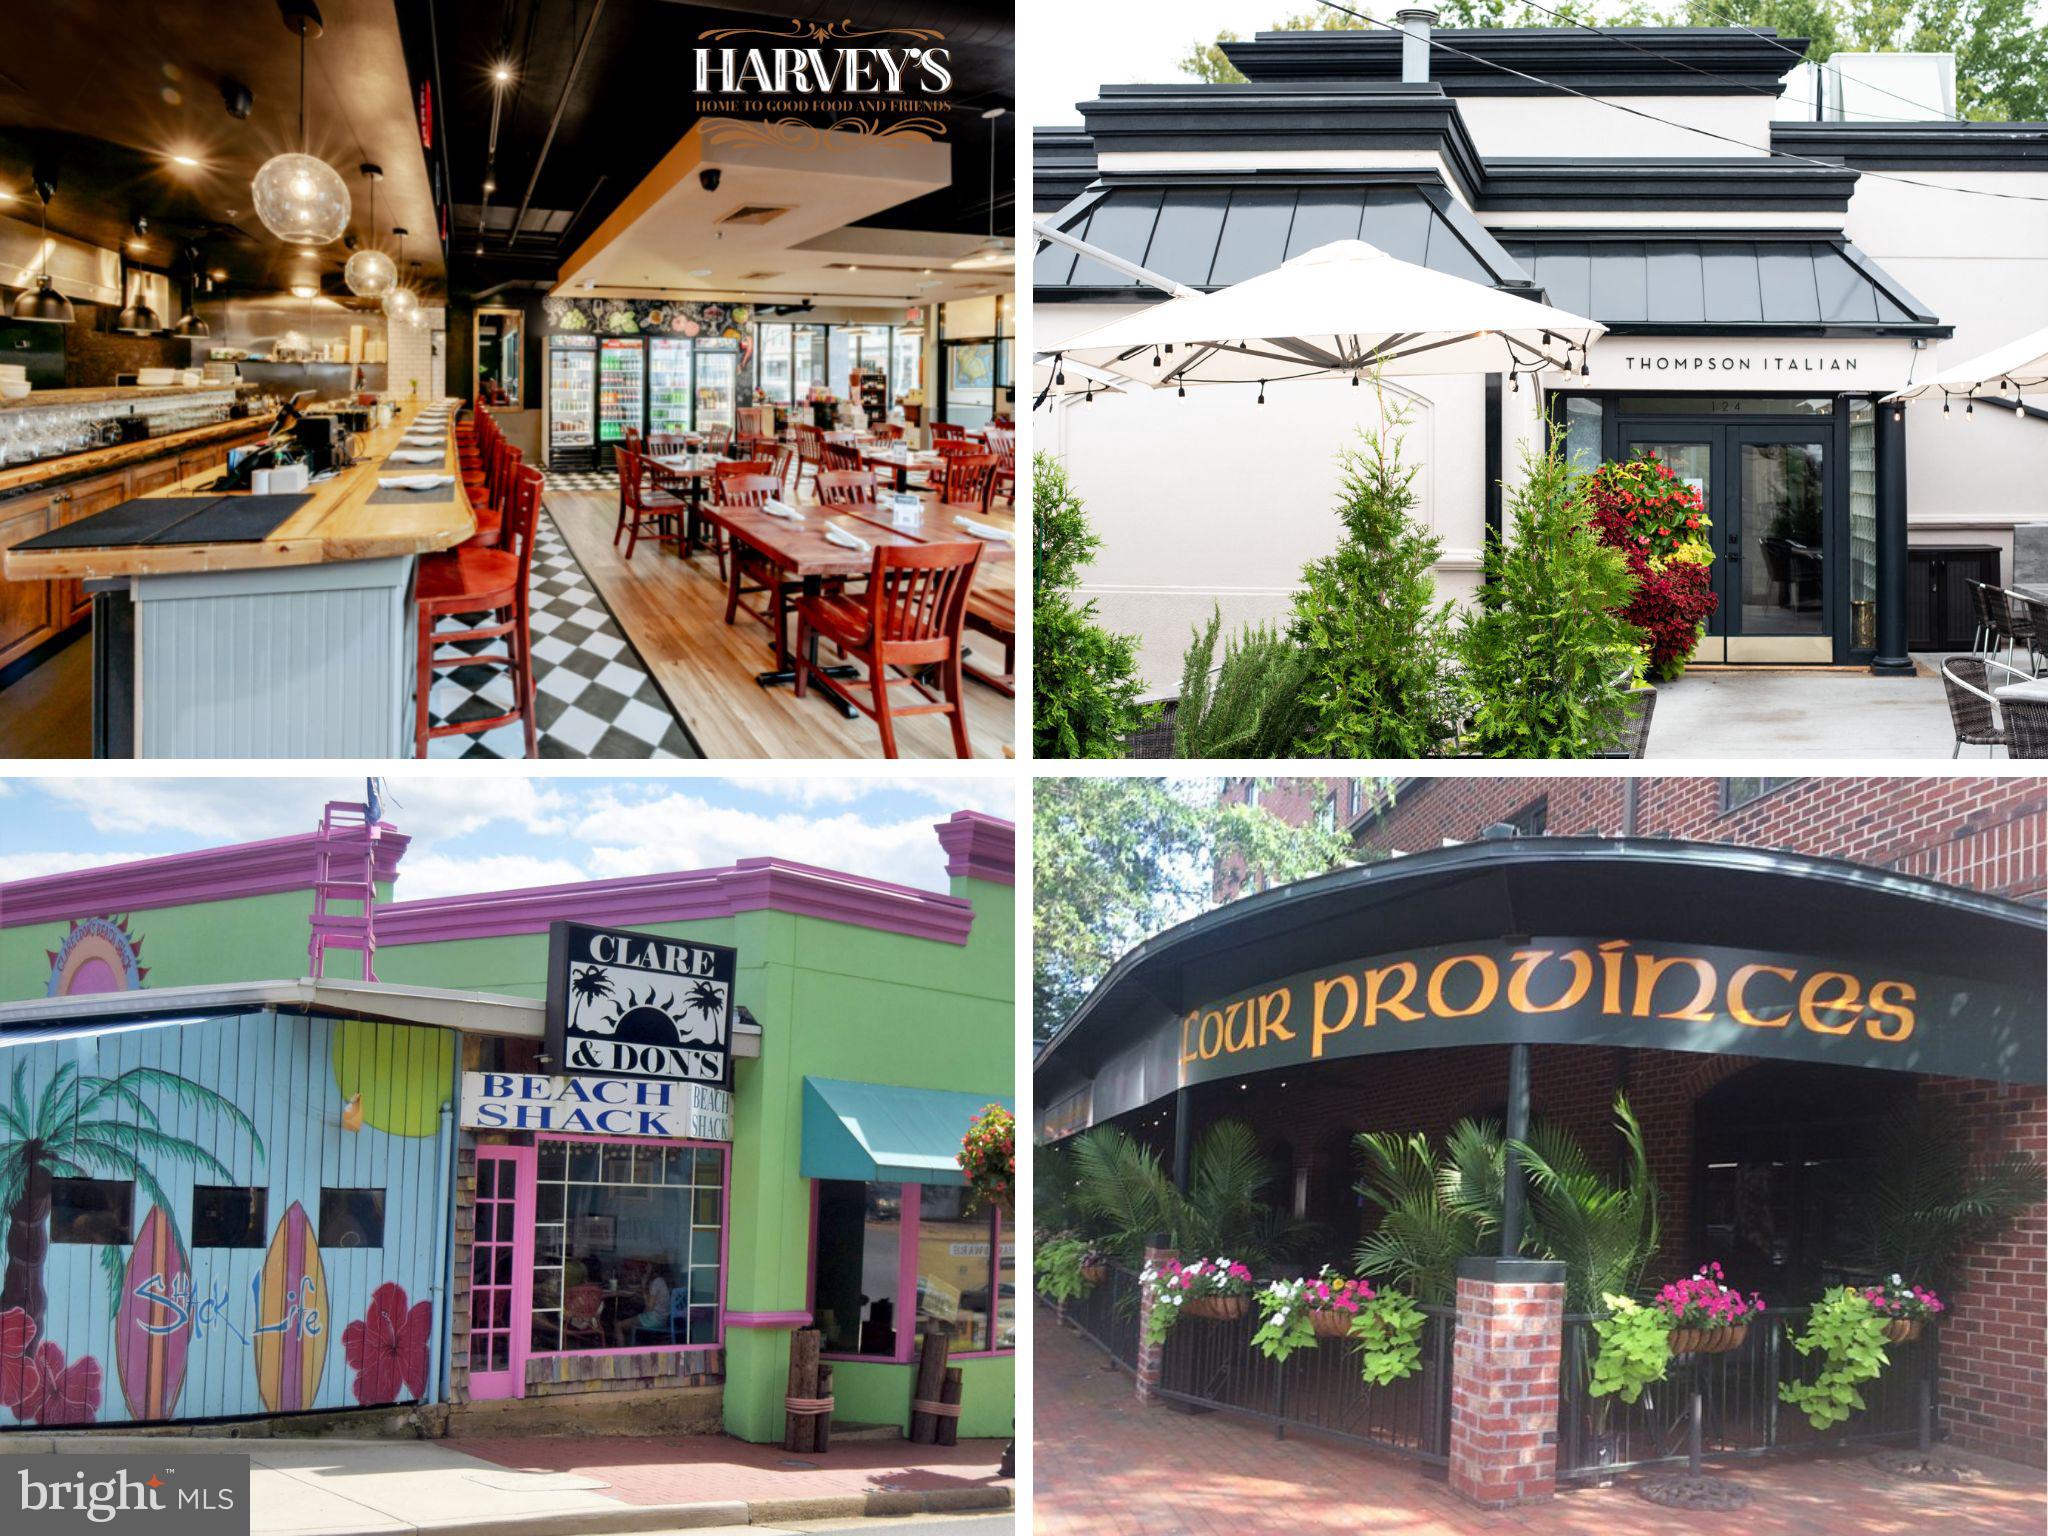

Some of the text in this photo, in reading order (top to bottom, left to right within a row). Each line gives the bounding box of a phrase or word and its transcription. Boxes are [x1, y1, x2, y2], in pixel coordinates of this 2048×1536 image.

[1625, 357, 1857, 371] THOMPSON ITALIAN
[589, 934, 715, 978] CLARE
[571, 1040, 719, 1079] & DON'S
[479, 1074, 675, 1107] BEACH
[693, 1086, 730, 1114] BEACH
[476, 1103, 673, 1136] SHACK
[691, 1114, 729, 1140] SHACK
